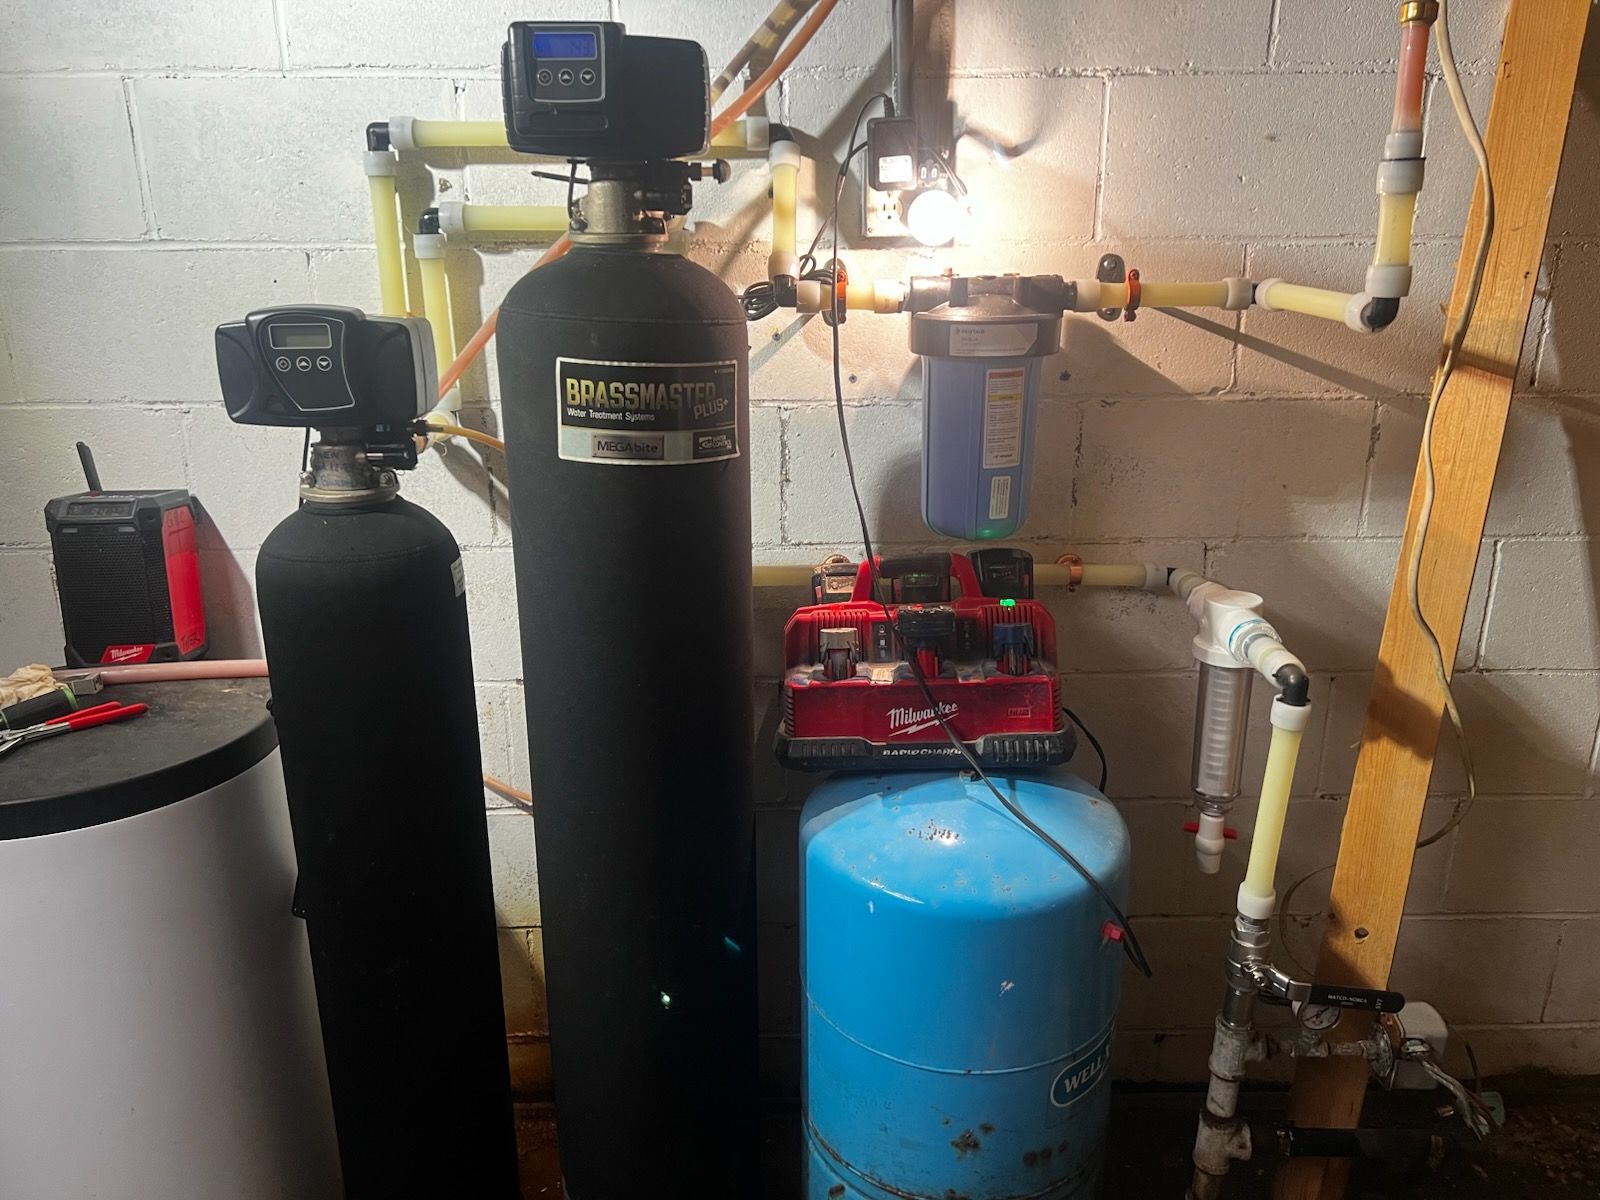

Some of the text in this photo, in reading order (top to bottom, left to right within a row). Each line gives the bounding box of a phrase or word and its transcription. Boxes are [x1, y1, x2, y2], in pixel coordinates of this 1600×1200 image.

[566, 408, 655, 422] Water Treatment Systems
